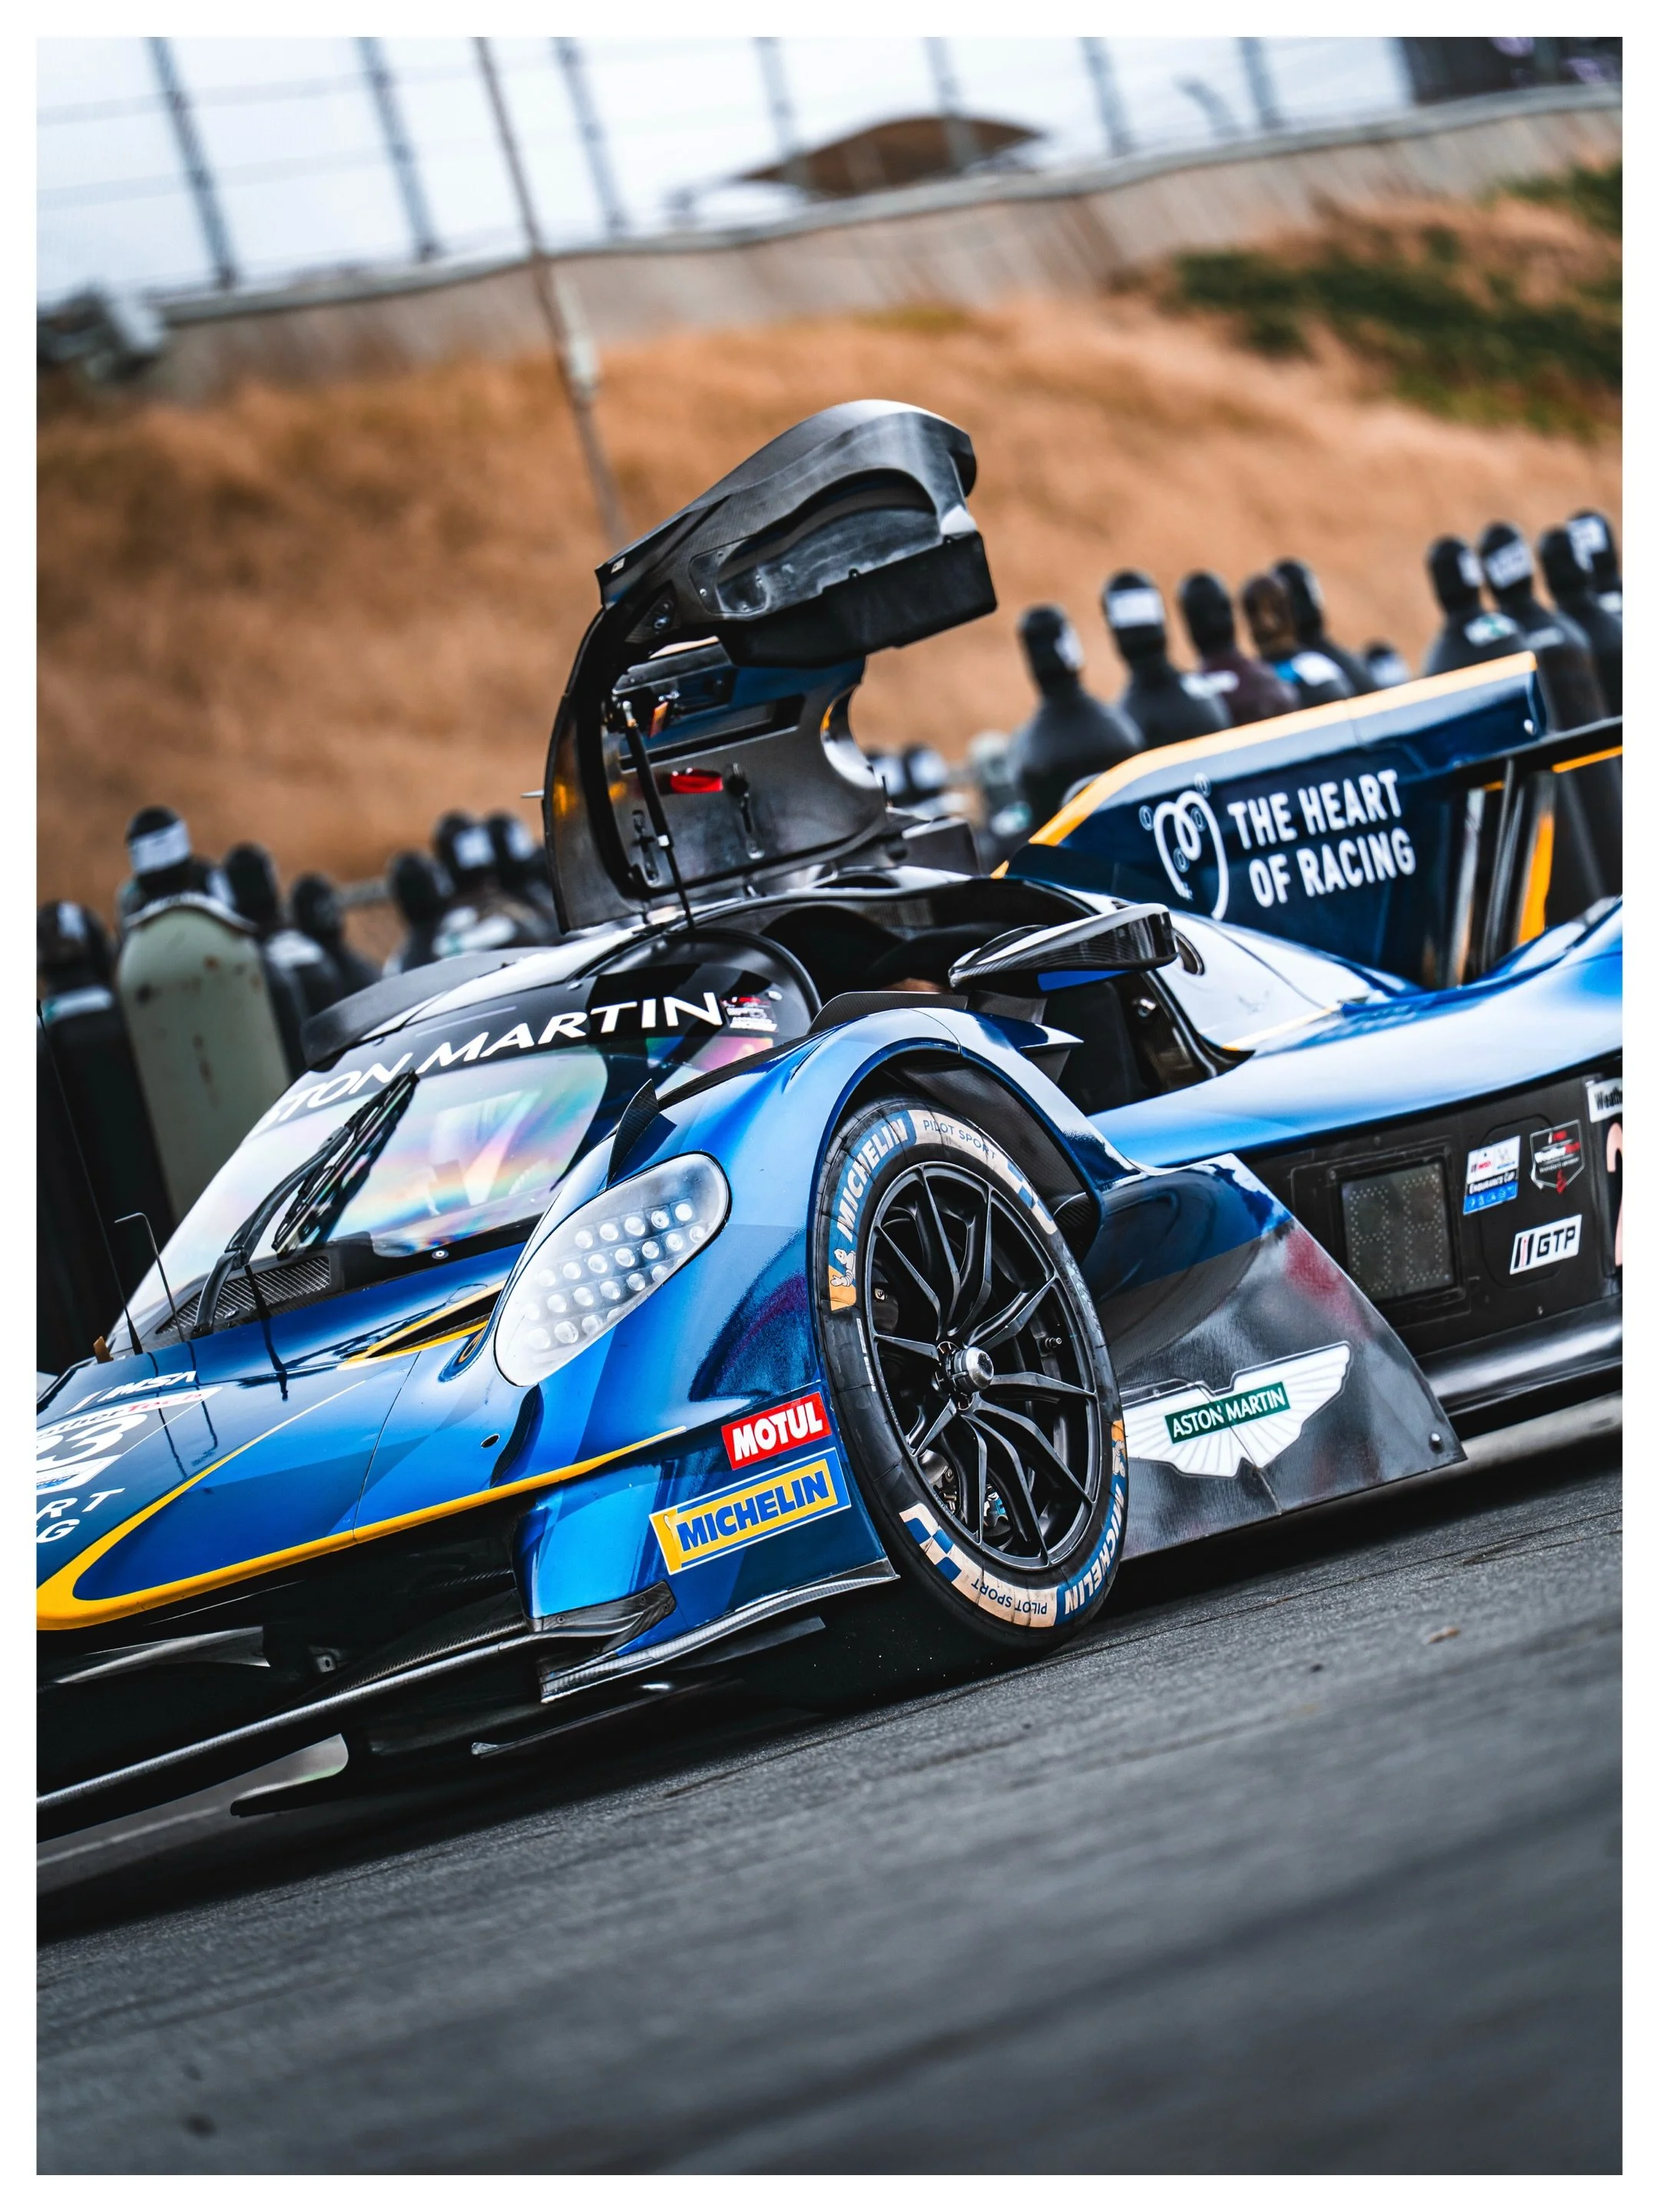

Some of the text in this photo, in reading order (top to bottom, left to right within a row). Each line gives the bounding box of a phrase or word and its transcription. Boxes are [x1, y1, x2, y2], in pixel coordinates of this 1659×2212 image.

[1228, 769, 1402, 849] THE HEART
[1249, 827, 1416, 908] OF RACING
[418, 992, 724, 1073] MARTIN
[837, 1118, 997, 1243] MICHELIN PILOT SPORT
[1537, 1226, 1576, 1258] GTP
[97, 1371, 197, 1402] IMSA
[1173, 1387, 1286, 1437] ASTON MARTIN
[732, 1402, 823, 1461] MOTUL
[676, 1470, 830, 1551] MICHELIN
[971, 1483, 1124, 1614] MICHELIN PILOT SPORT
